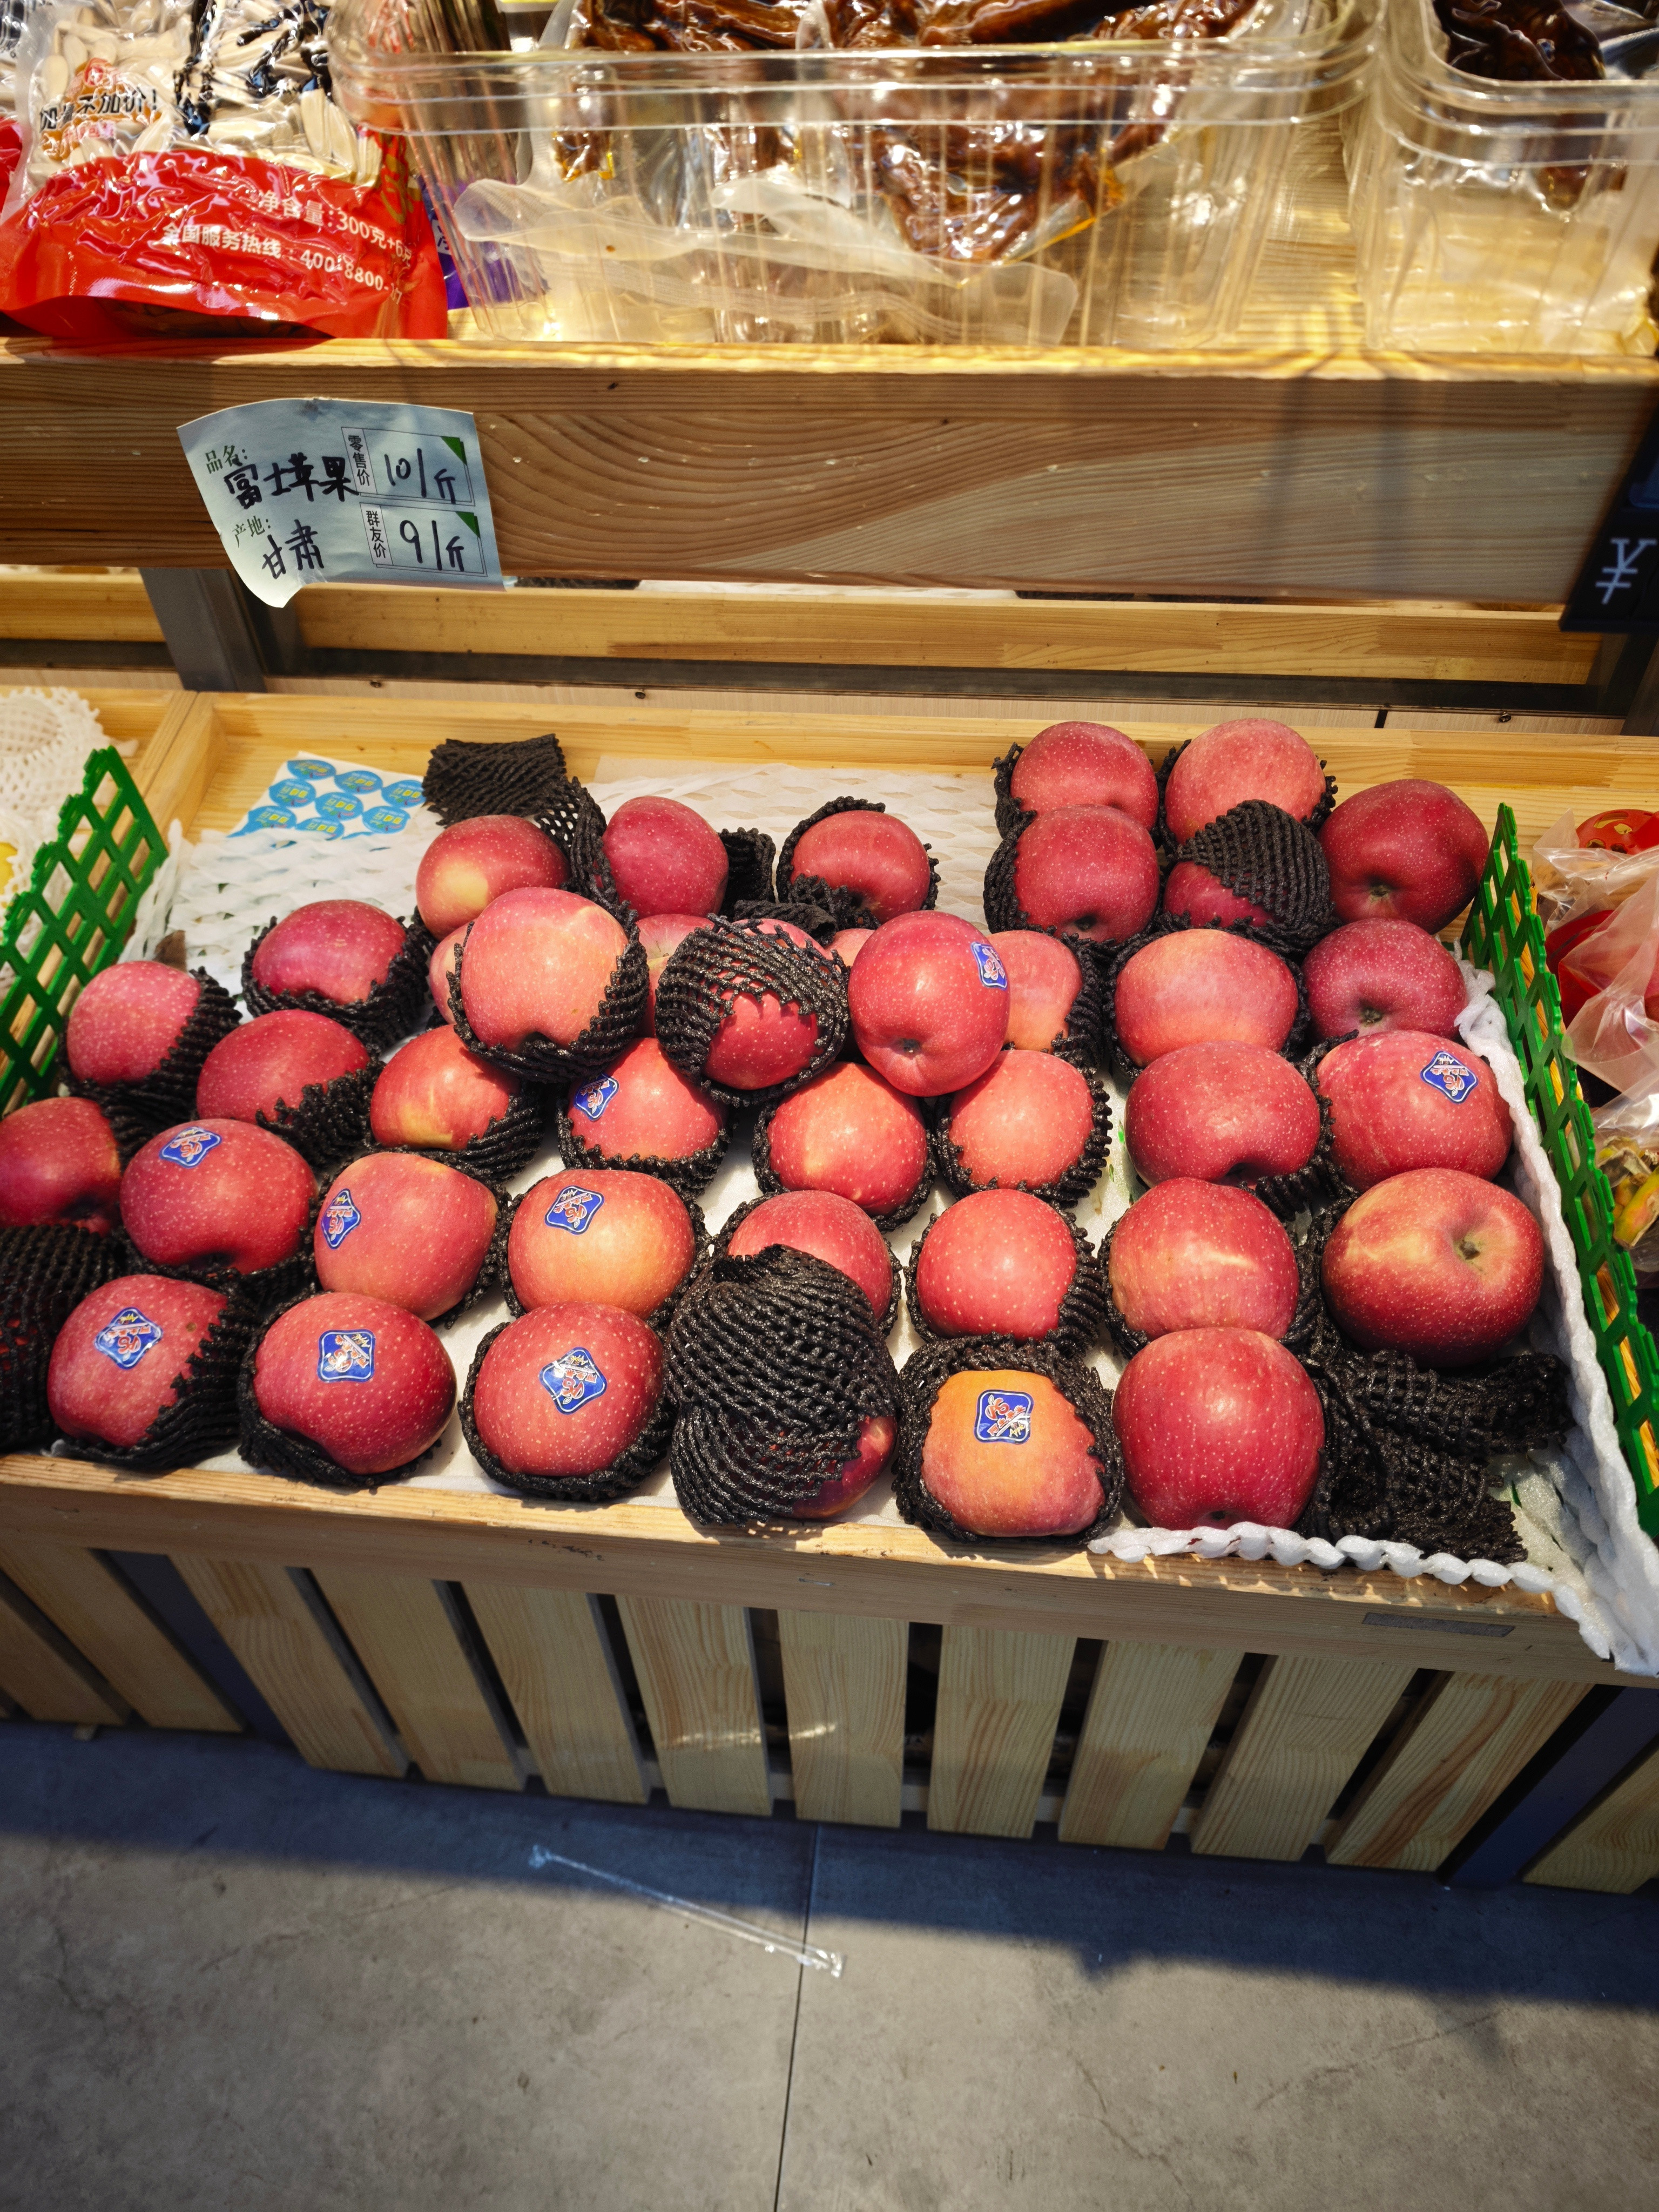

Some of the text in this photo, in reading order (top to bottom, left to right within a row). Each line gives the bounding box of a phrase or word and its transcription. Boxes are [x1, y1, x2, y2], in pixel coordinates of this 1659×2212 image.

[223, 451, 359, 510] 富士苹果
[347, 435, 370, 487] 零售价
[232, 515, 271, 548] 产地：
[261, 520, 325, 579] 甘肃
[366, 510, 387, 559] 群友价
[553, 1368, 597, 1384] 阿生果
